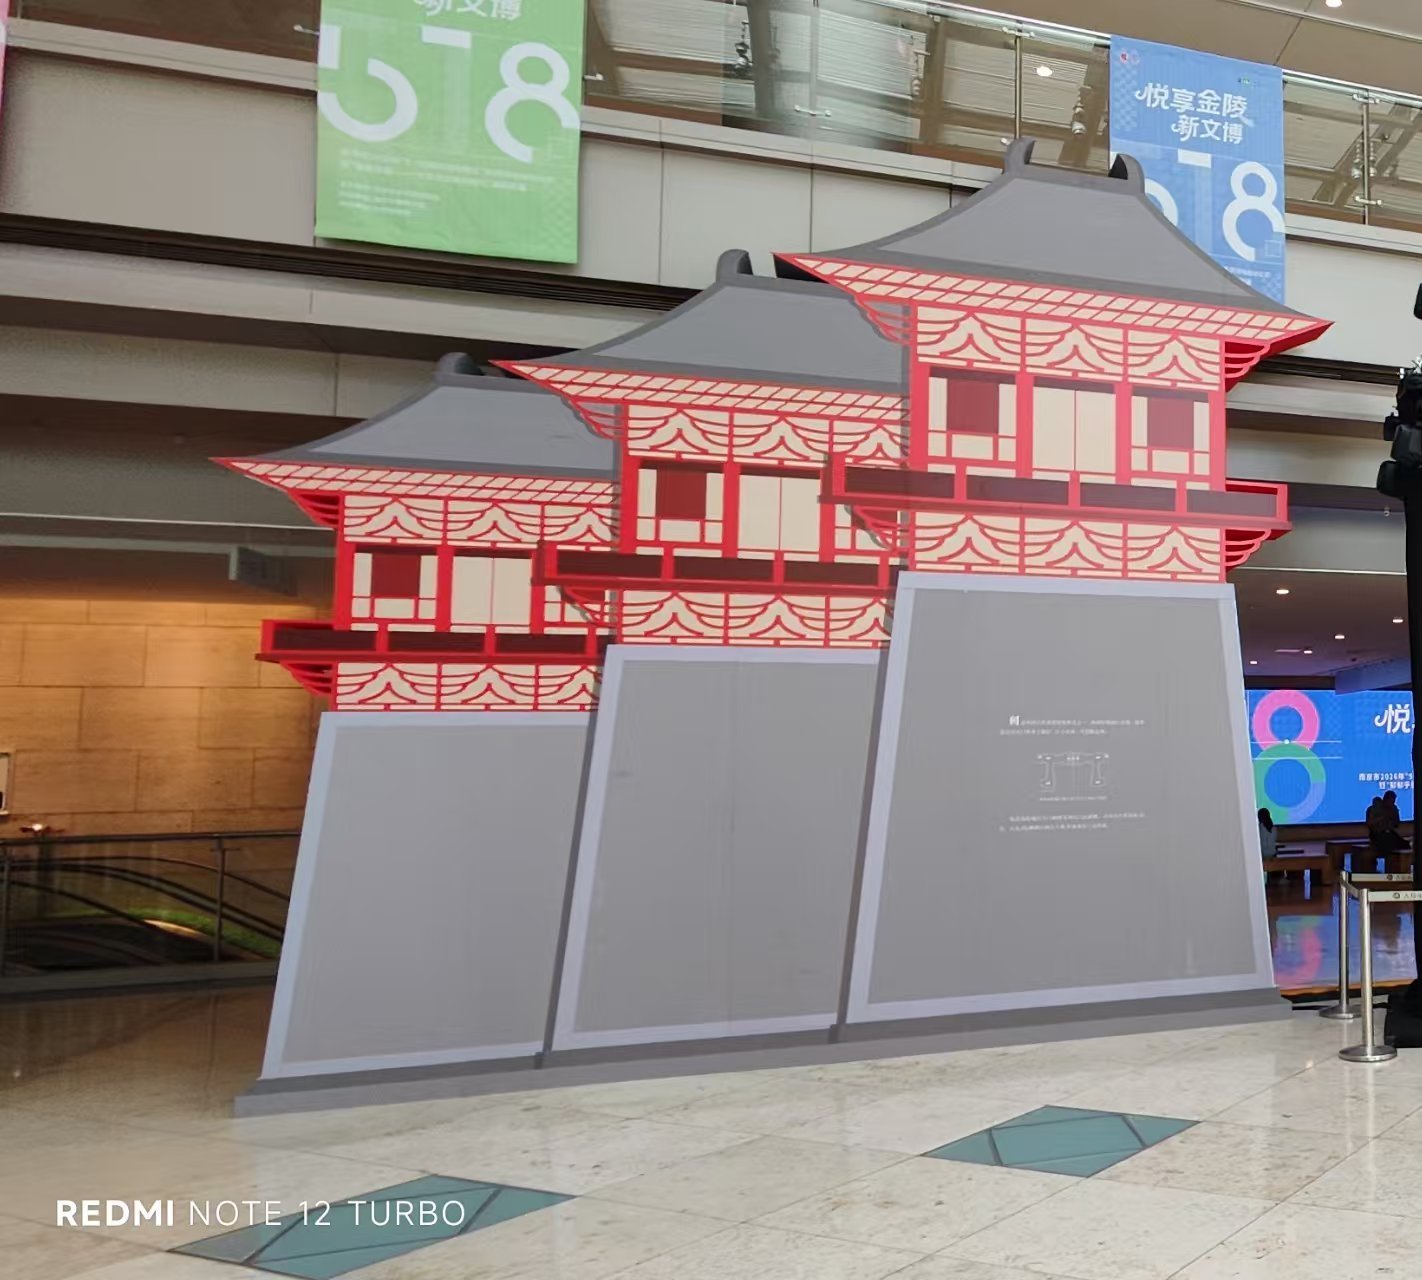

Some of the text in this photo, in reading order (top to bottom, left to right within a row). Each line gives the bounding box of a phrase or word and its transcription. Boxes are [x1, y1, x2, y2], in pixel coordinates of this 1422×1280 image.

[1135, 82, 1254, 127] 悦享金陵
[1171, 114, 1243, 144] 新文博
[1374, 704, 1415, 733] 悦
